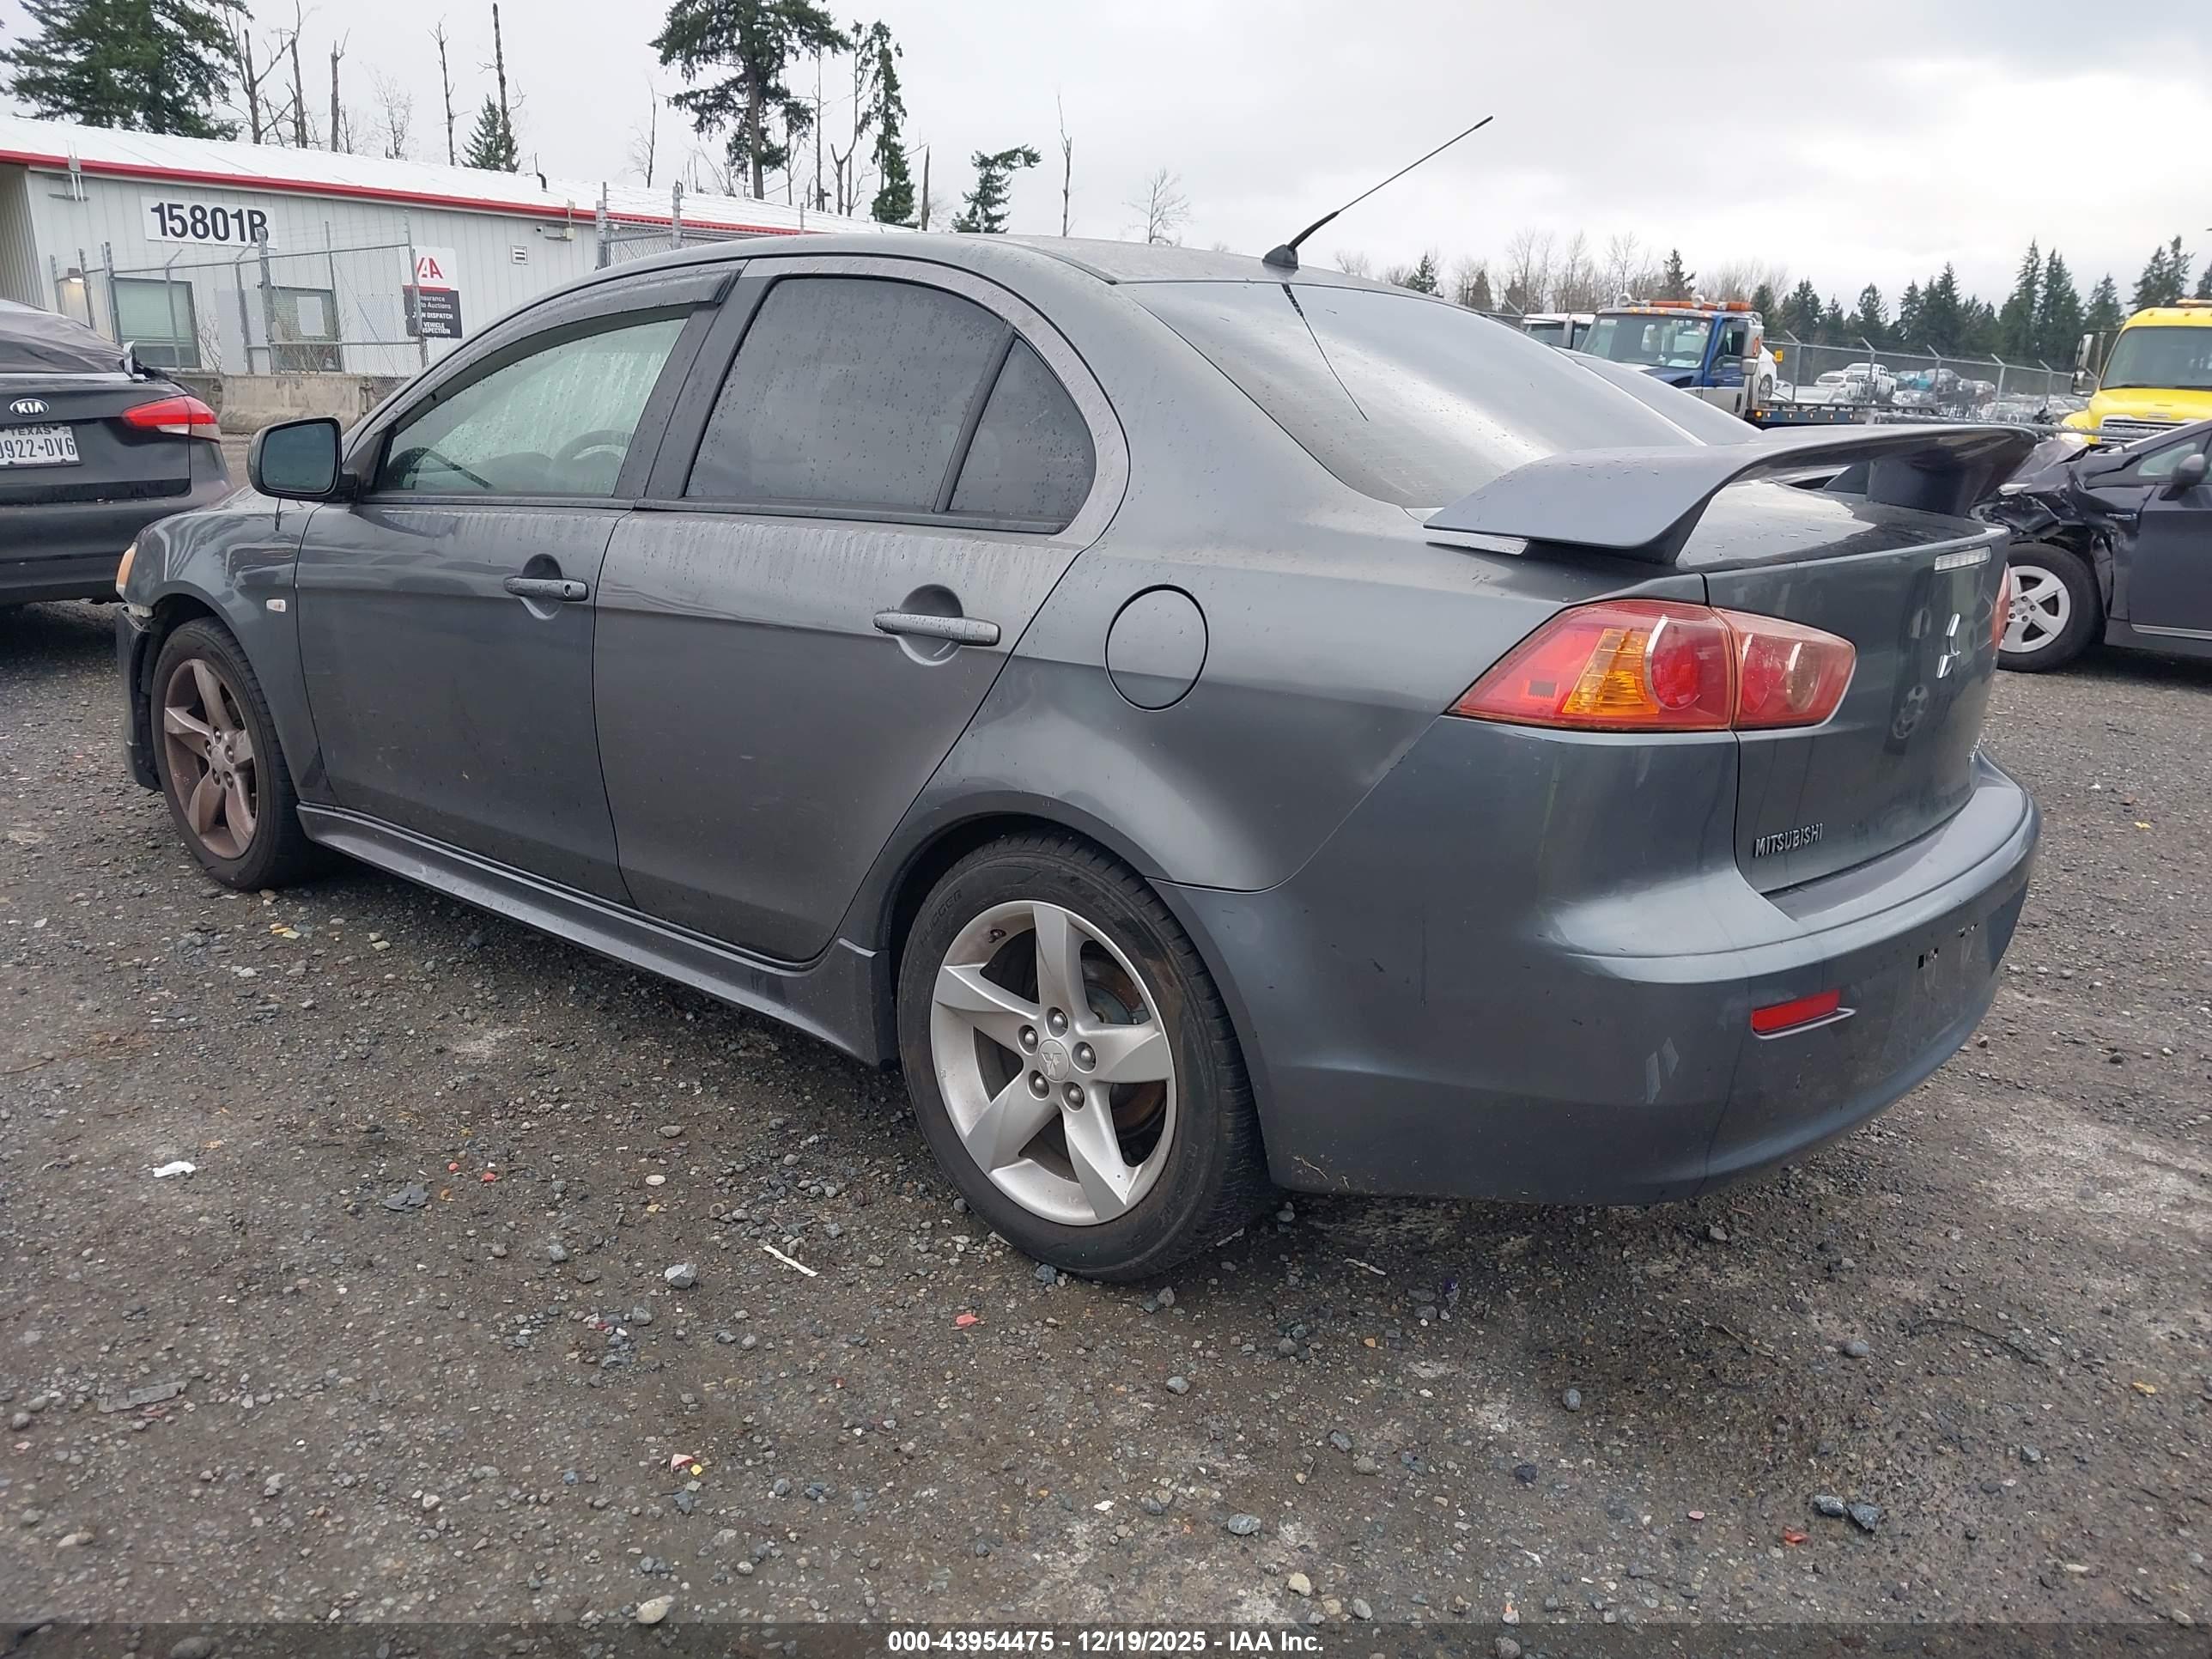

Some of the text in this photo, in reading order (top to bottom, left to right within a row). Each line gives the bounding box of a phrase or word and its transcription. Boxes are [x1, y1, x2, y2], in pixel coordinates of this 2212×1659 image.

[150, 202, 269, 243] 15801B
[15, 401, 45, 414] KIA
[10, 426, 52, 436] TEXAS
[1753, 823, 1823, 858] MITSUBISHI
